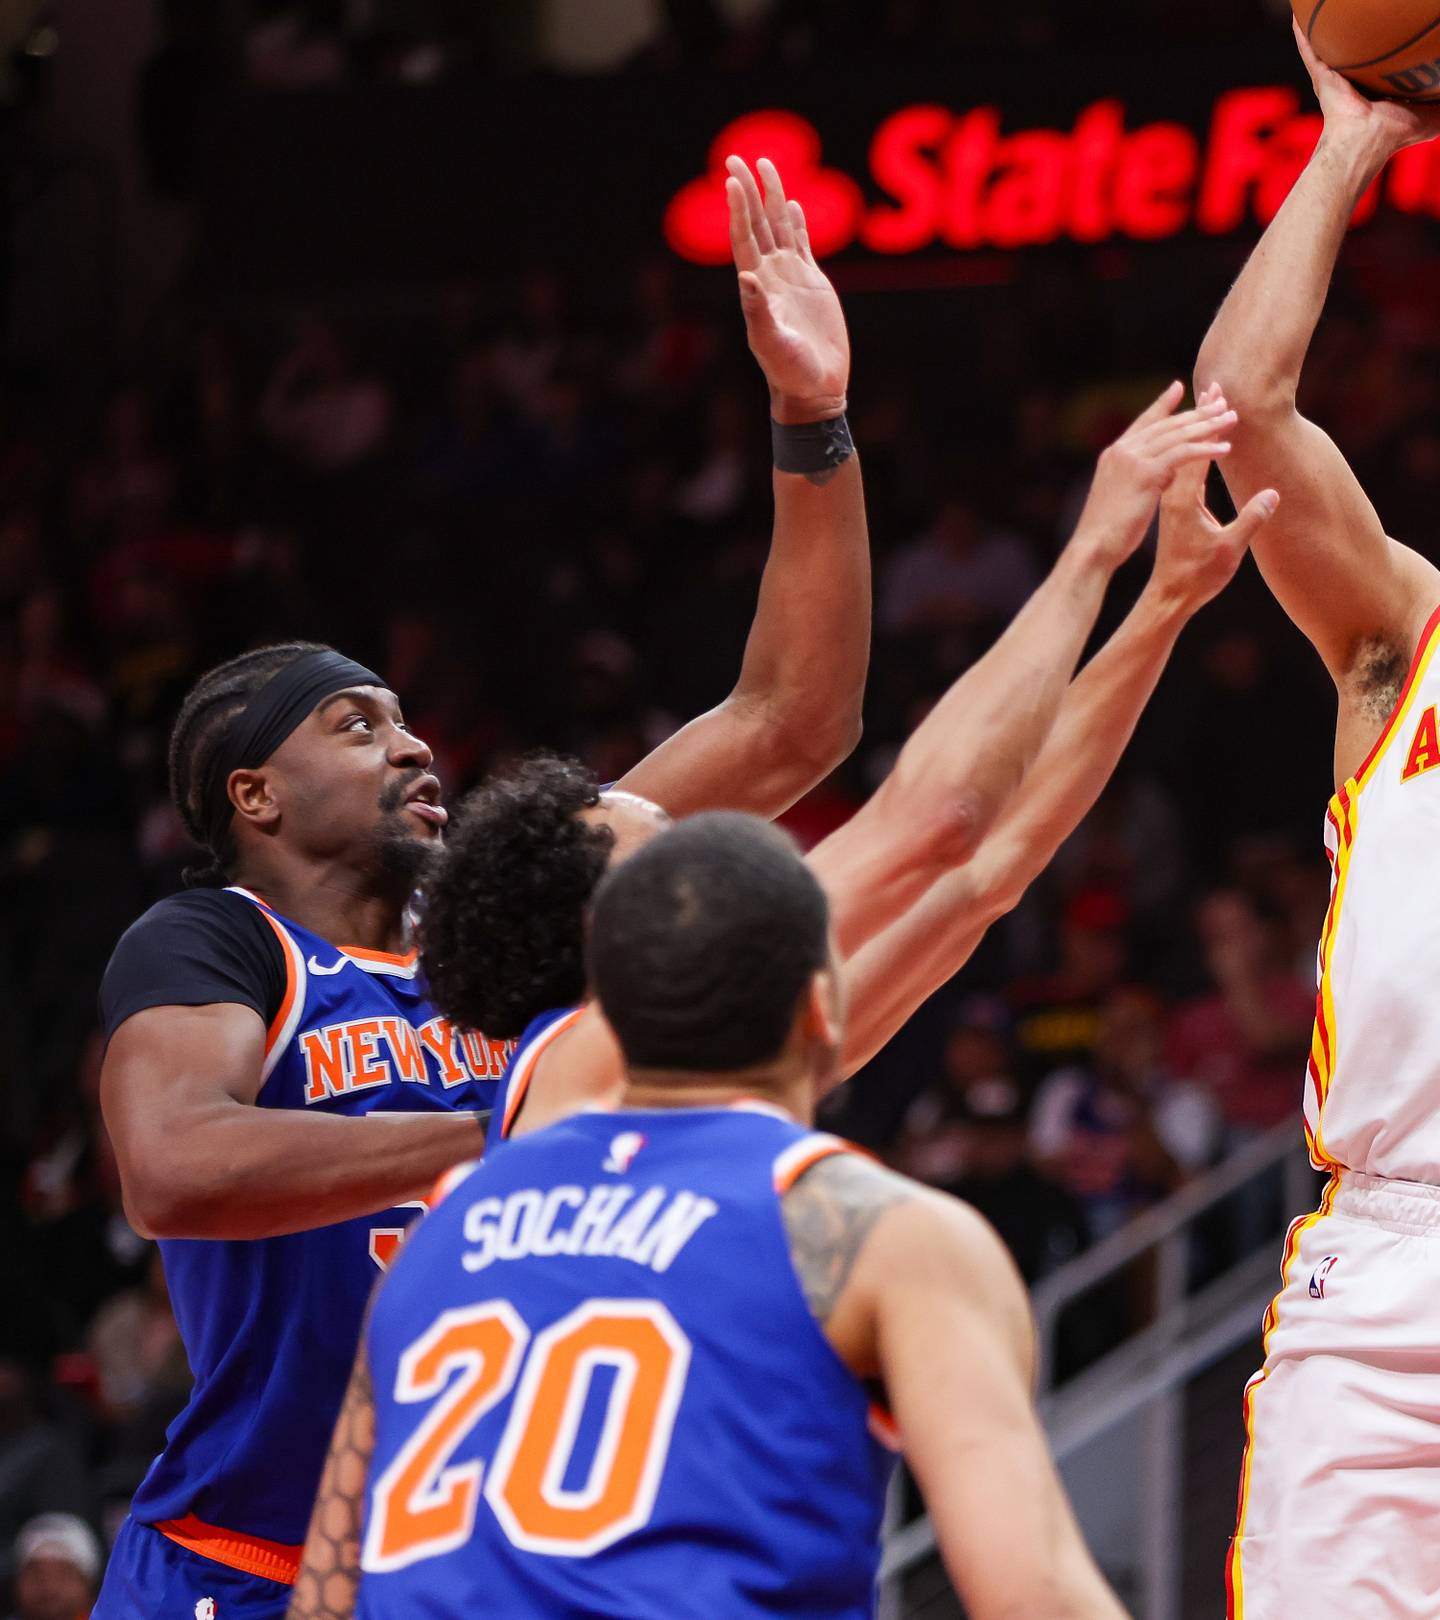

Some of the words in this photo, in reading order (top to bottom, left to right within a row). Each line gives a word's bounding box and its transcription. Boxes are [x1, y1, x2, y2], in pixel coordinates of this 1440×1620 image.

[861, 98, 1197, 256] State
[299, 1016, 430, 1105] NEW
[417, 1015, 519, 1089] YOR
[462, 1184, 719, 1273] SOCHAN
[361, 1297, 693, 1573] 20
